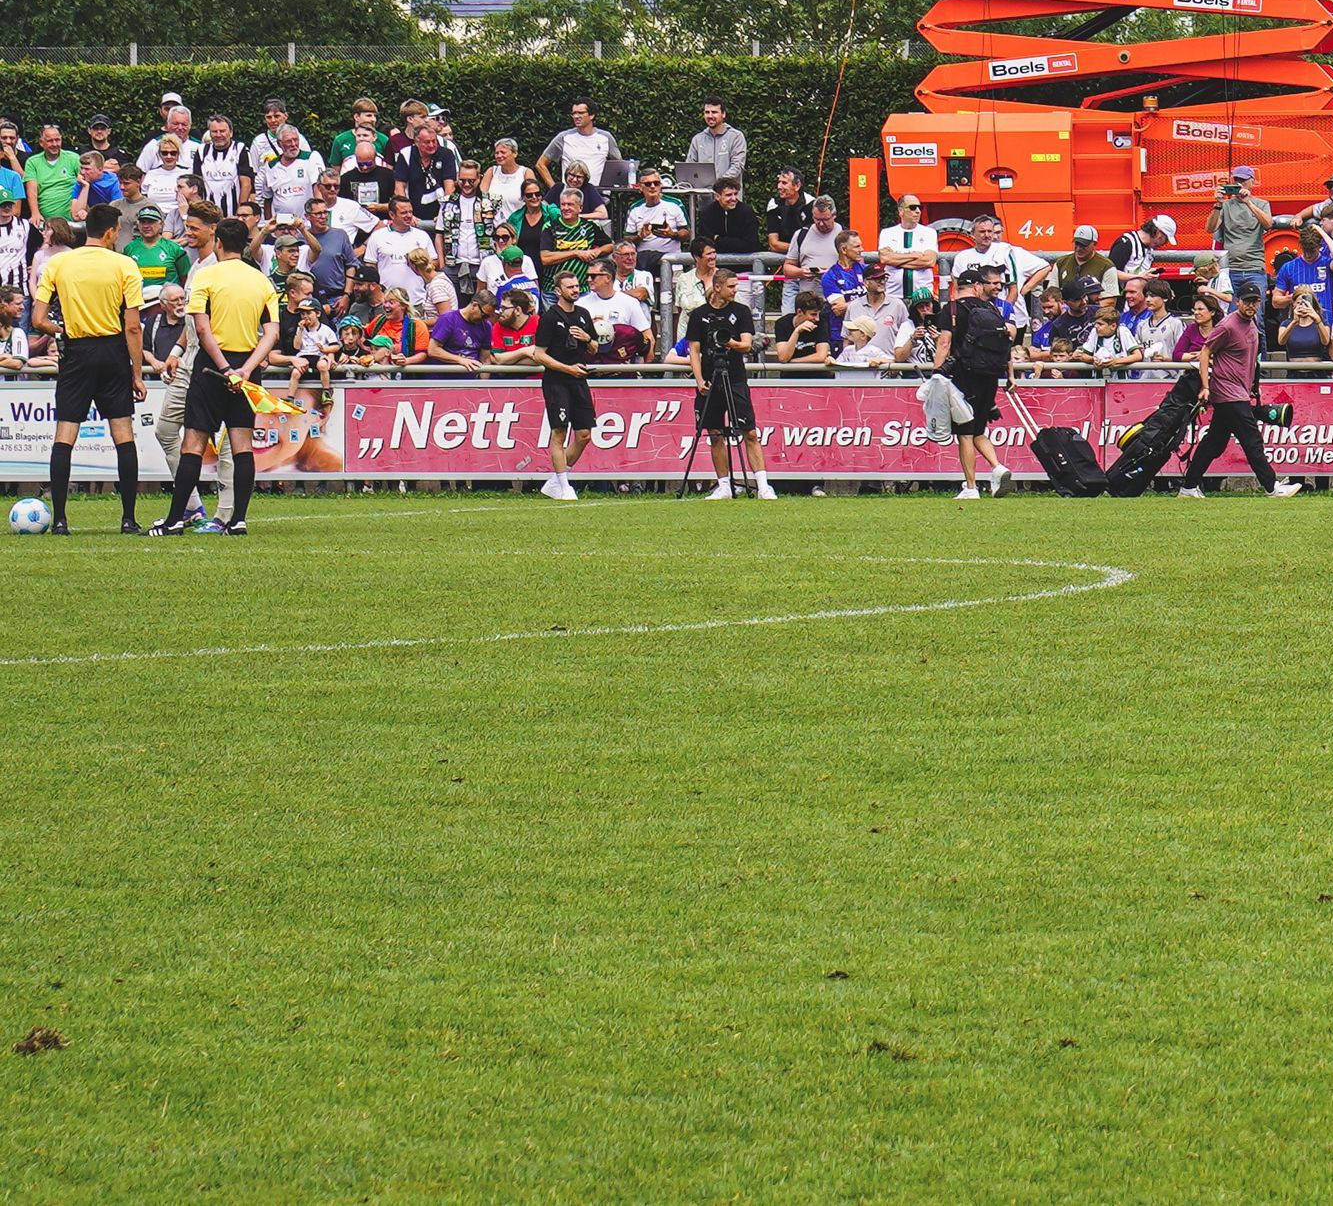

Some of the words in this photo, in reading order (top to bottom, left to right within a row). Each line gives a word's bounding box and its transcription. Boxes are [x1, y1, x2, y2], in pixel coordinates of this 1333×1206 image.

[992, 61, 1045, 77] Boels
[892, 146, 935, 156] Boels
[783, 424, 865, 447] waren
[880, 420, 928, 447] Sie
